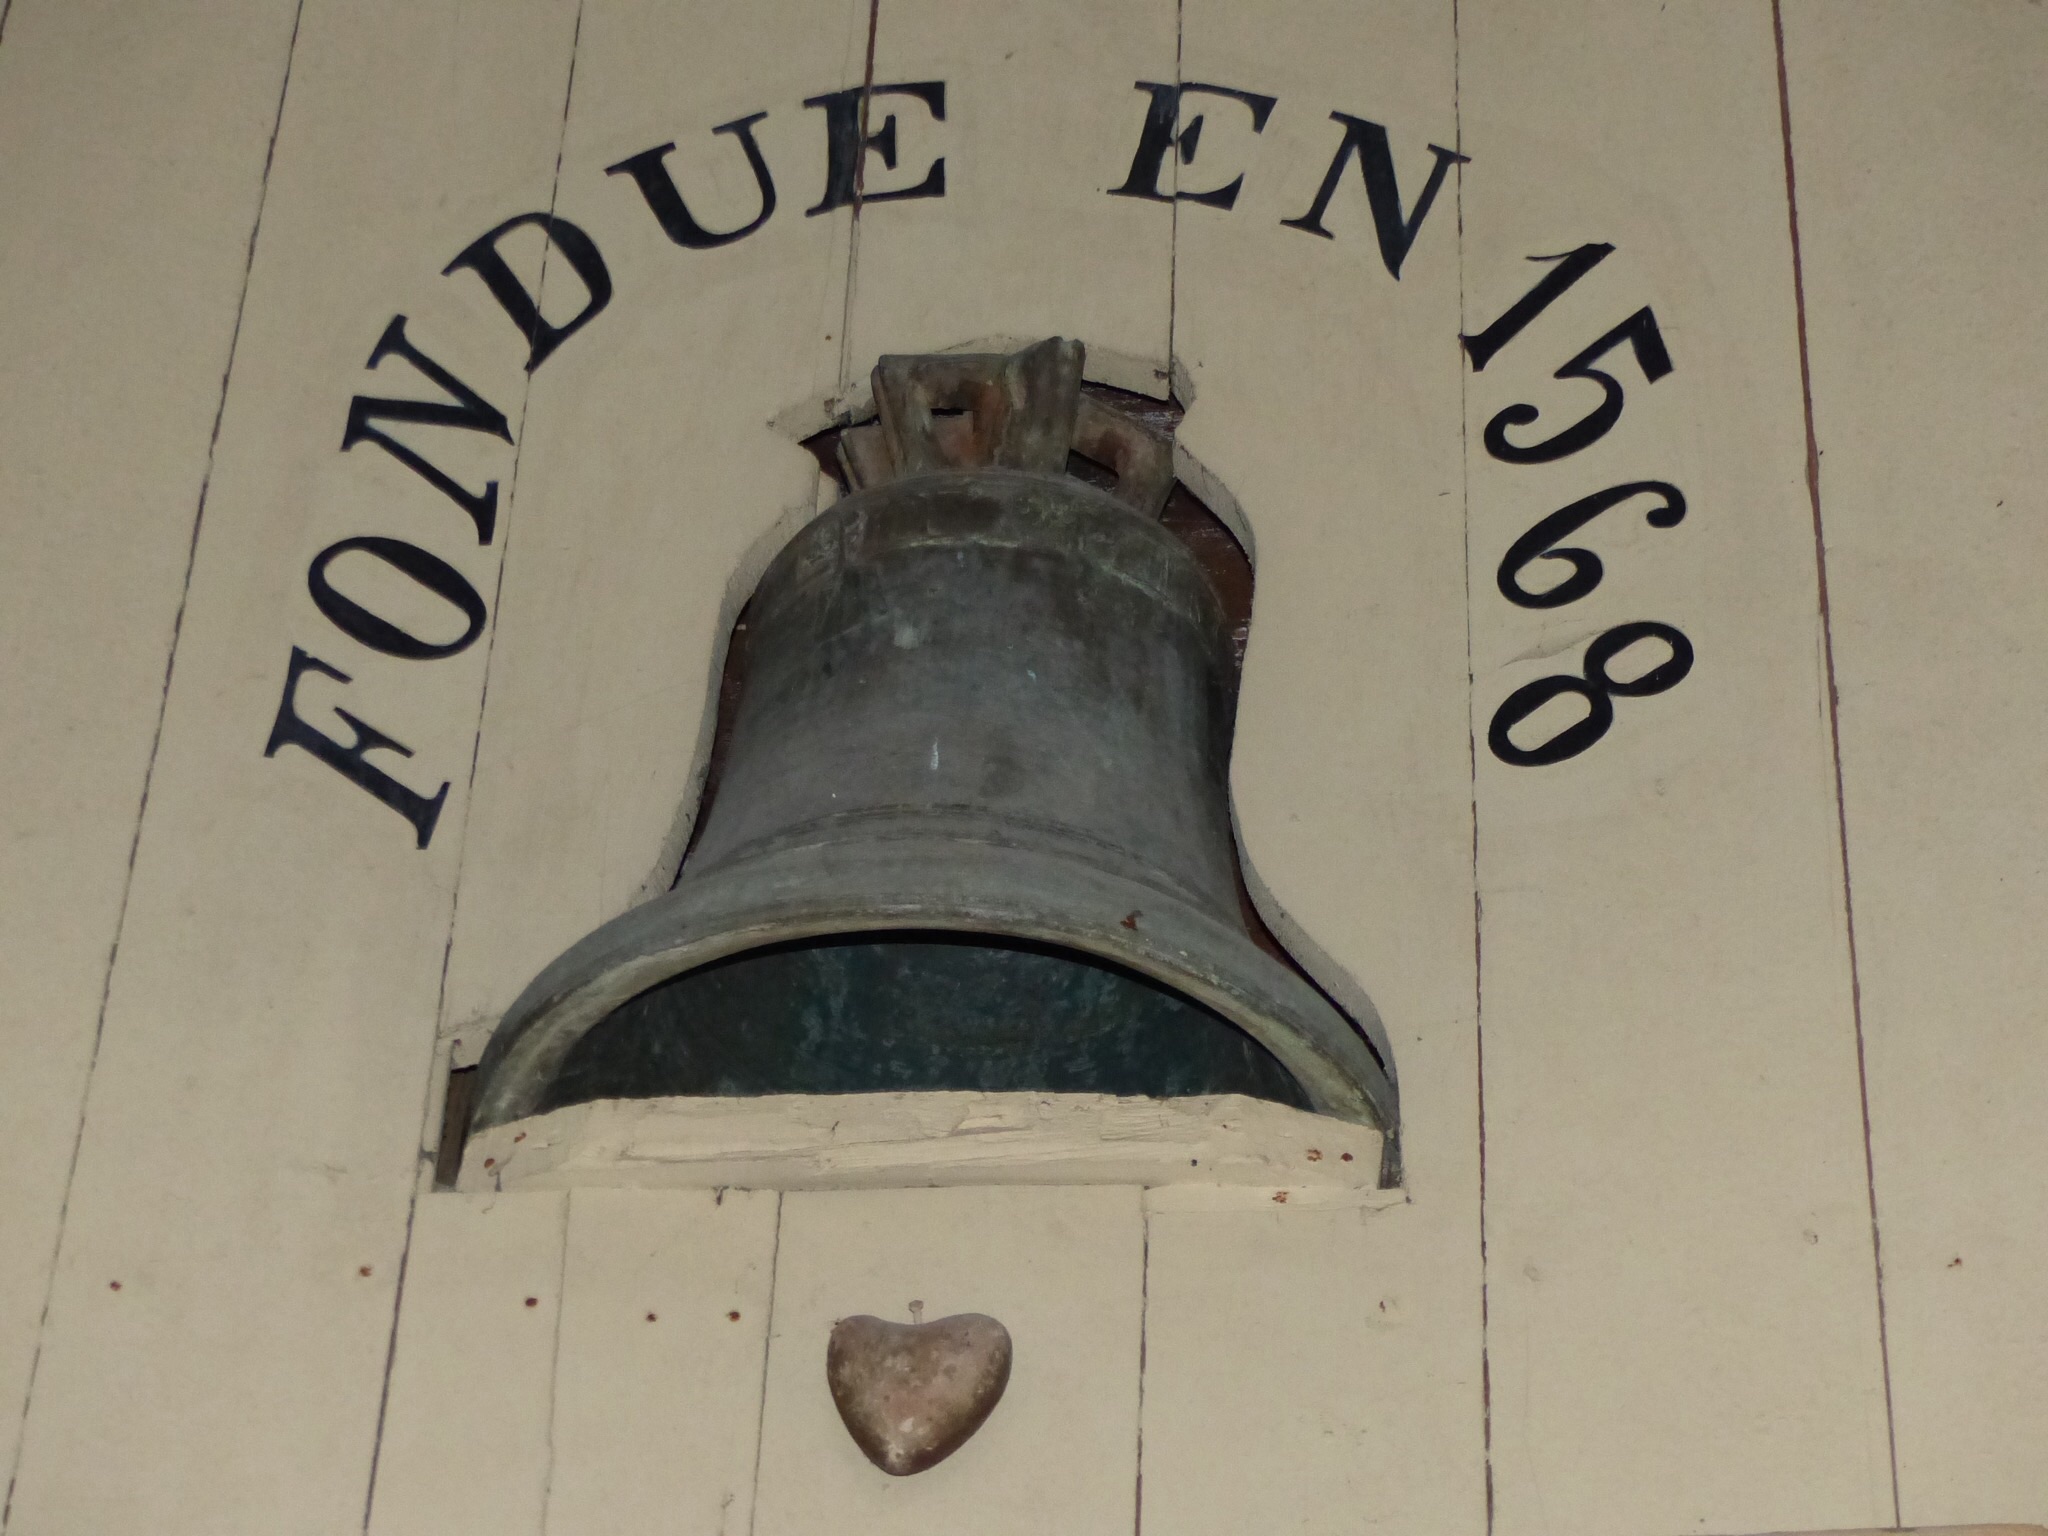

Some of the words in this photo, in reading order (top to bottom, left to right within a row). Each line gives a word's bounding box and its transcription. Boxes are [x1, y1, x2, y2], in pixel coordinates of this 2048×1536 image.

[264, 80, 946, 851] FONDUE
[1106, 80, 1472, 282] EN
[1459, 242, 1695, 767] 1568
